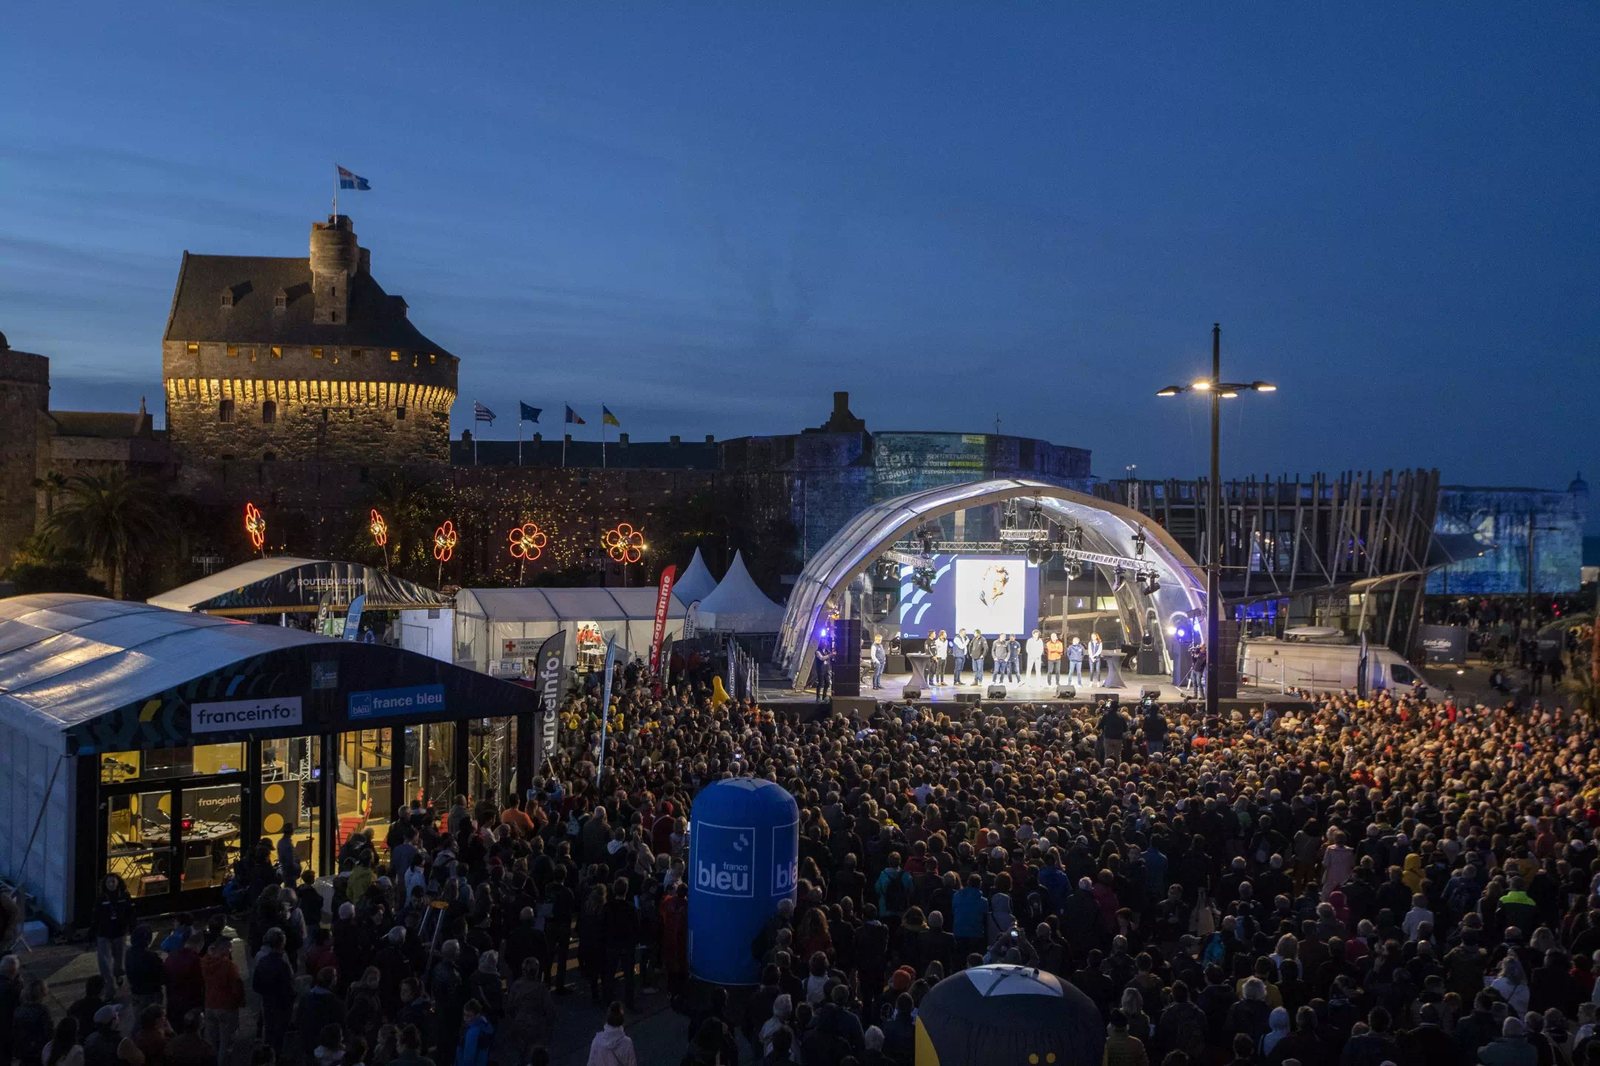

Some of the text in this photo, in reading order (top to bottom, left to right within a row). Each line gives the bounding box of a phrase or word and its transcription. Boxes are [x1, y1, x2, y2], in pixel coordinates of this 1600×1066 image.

[297, 578, 326, 587] ROUTE
[373, 696, 413, 709] france
[416, 692, 443, 705] bleu
[722, 861, 748, 872] france
[776, 860, 798, 889] ble
[698, 860, 748, 891] bleu
